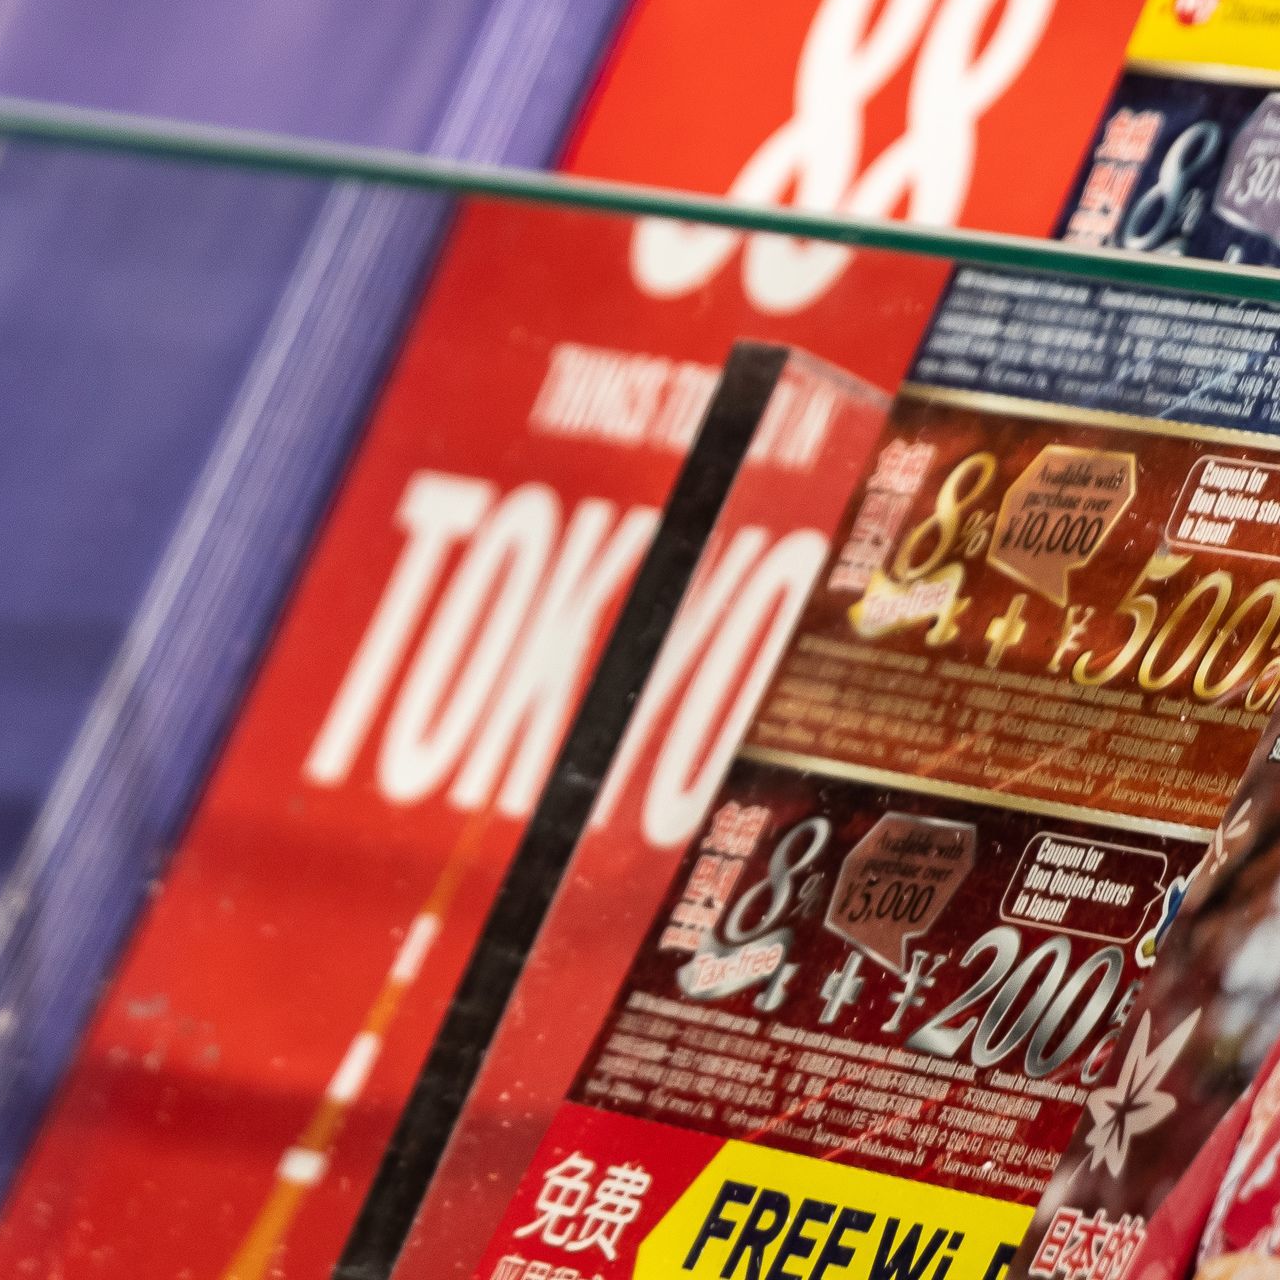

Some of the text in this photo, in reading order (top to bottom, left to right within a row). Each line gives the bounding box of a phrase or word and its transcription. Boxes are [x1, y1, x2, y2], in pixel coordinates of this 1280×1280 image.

[1199, 459, 1270, 494] Coupon for
[1176, 512, 1195, 540] in
[1187, 486, 1217, 515] Don
[1213, 488, 1260, 521] Quijote
[1000, 511, 1104, 558] ¥10,000
[1036, 836, 1106, 872] Coupon for
[839, 879, 936, 924] ¥5,000
[1011, 889, 1029, 915] in
[1024, 863, 1136, 908] Don Quijote stores
[694, 942, 785, 991] Tax-free
[514, 1150, 653, 1261] 免费
[683, 1180, 877, 1280] FREE
